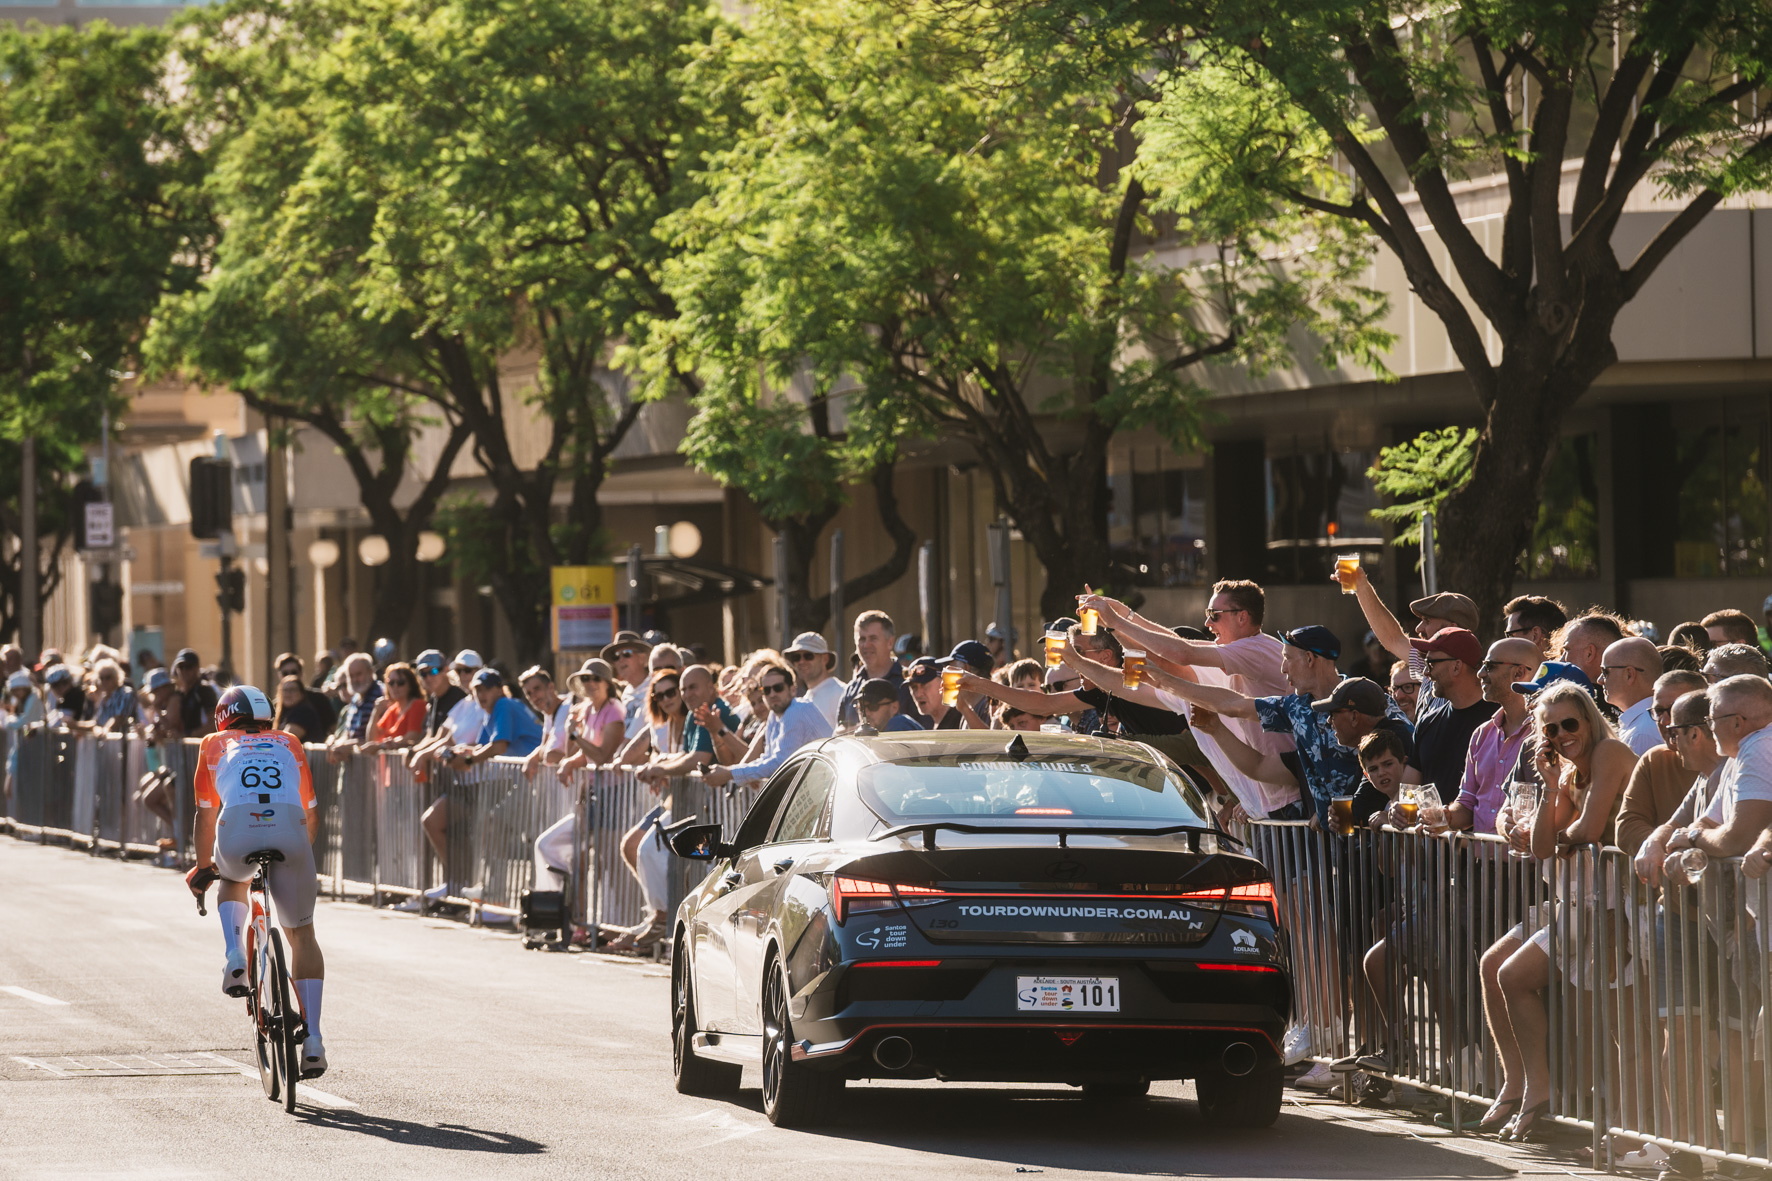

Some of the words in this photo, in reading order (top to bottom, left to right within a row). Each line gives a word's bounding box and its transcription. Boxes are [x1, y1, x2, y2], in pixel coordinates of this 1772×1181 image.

[216, 701, 240, 724] KASK
[241, 766, 282, 789] 63
[959, 761, 1078, 772] COMMISSAIRE
[1080, 764, 1093, 773] 3
[958, 905, 1191, 921] TOURDOWNUNDER.COM.AU
[1080, 985, 1115, 1006] 101
